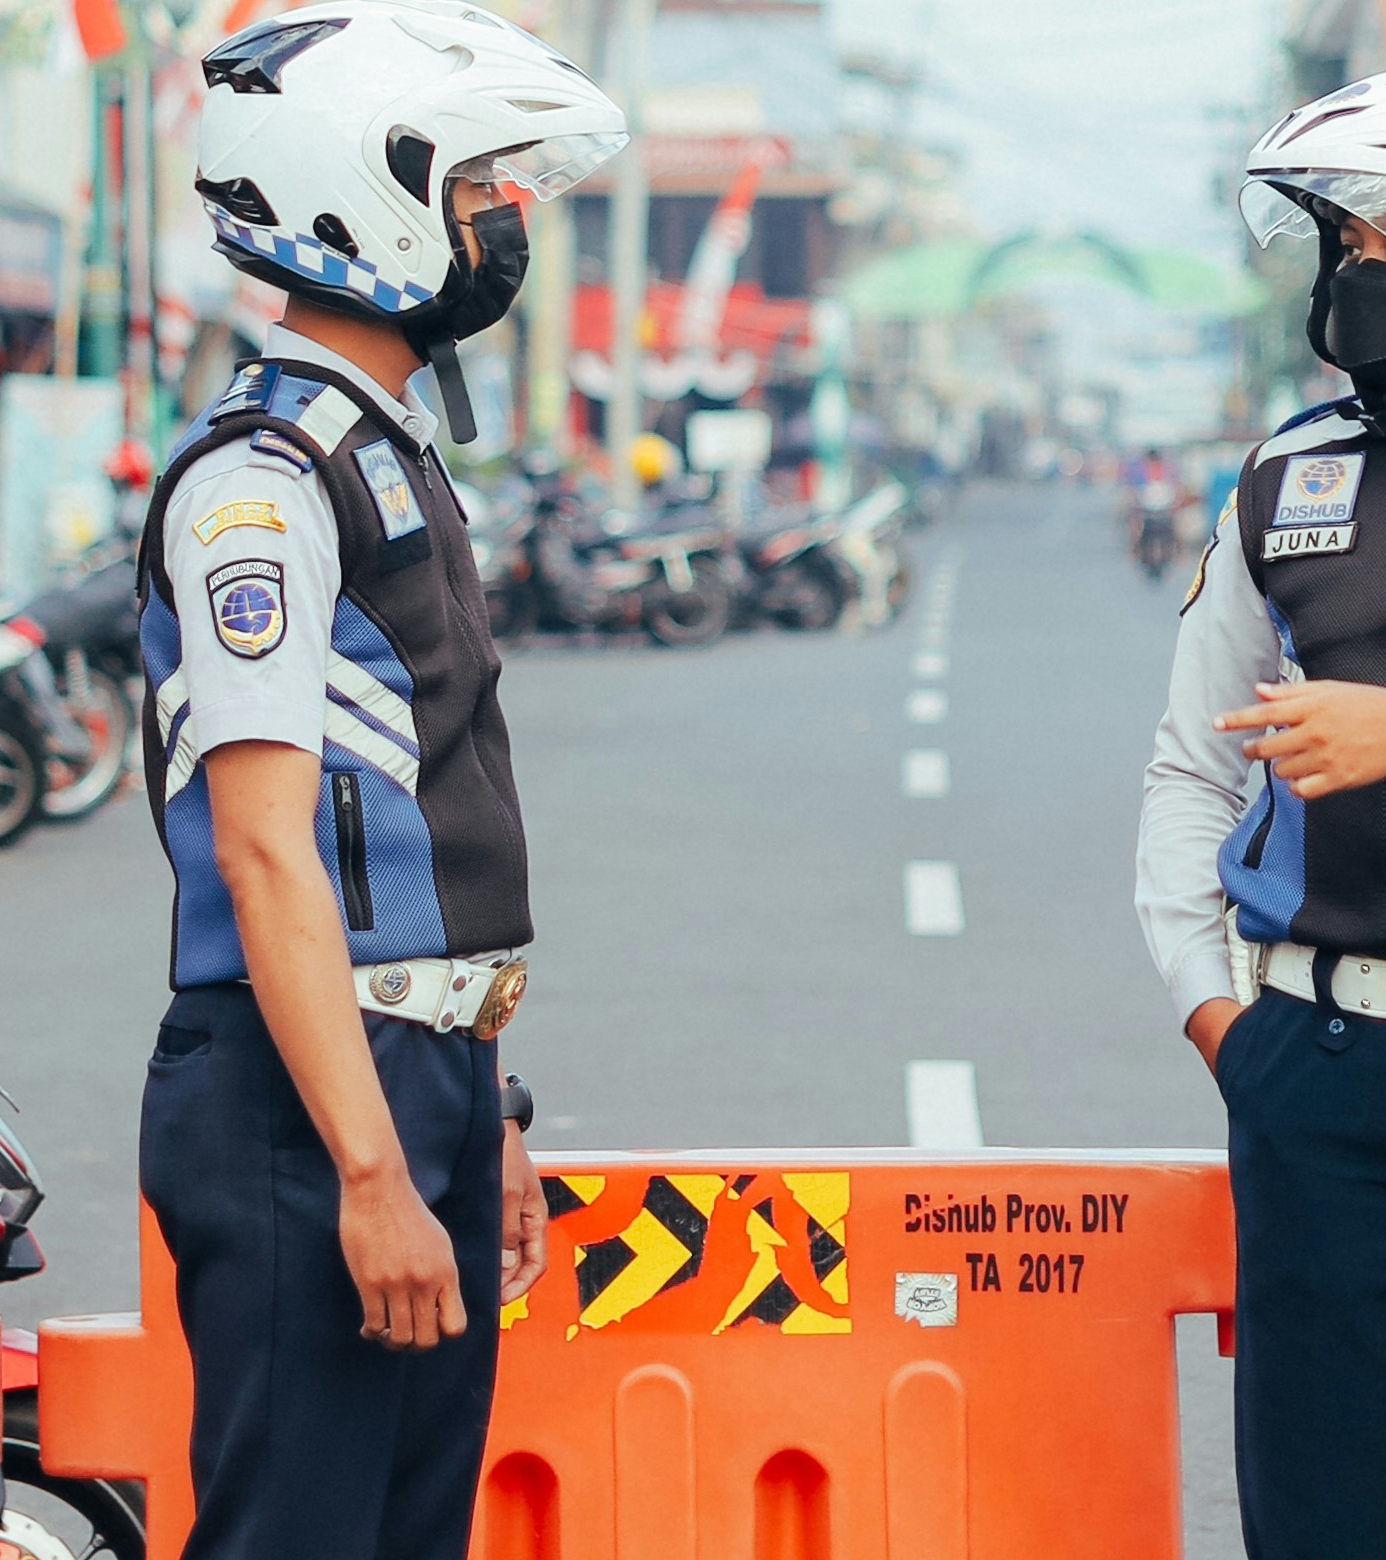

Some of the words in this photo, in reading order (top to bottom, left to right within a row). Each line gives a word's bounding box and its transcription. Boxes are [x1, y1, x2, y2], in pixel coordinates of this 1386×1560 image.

[1278, 503, 1347, 521] DISHUB
[1272, 530, 1339, 554] JUNA
[904, 1193, 997, 1233] Dishub
[1006, 1193, 1072, 1233] Prov.
[1082, 1193, 1129, 1233] DIY
[965, 1252, 1002, 1292] TA
[1018, 1253, 1085, 1294] 2017
